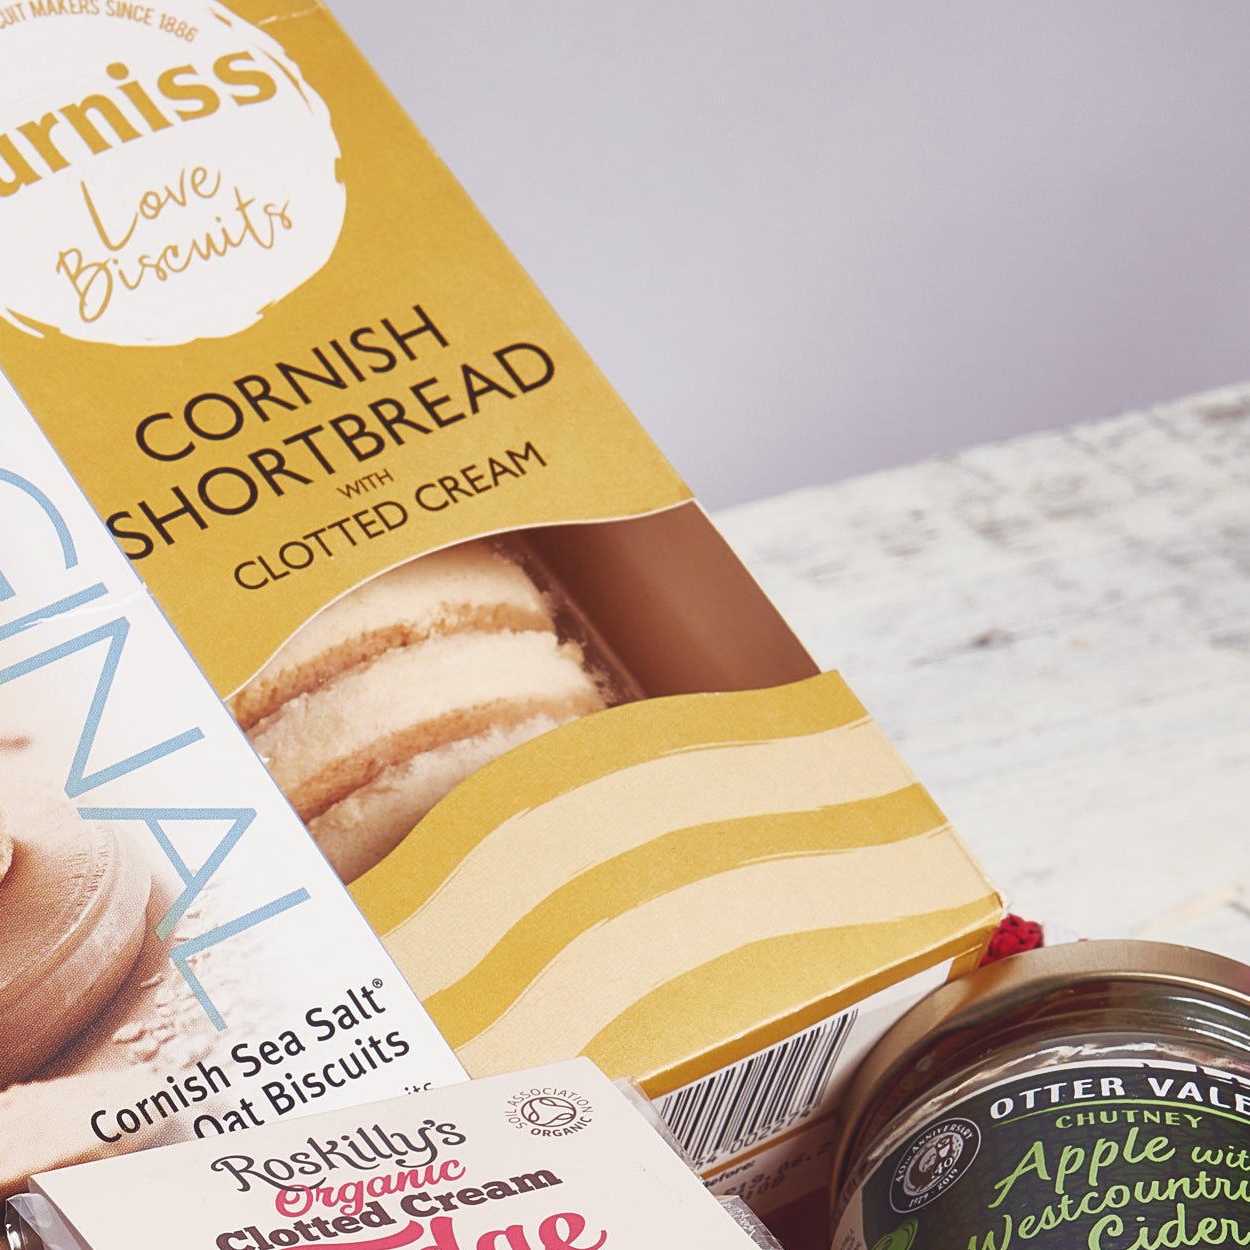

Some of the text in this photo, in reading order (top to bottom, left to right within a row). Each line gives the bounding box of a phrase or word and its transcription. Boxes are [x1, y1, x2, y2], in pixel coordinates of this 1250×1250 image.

[30, 0, 100, 18] MAKERS
[105, 0, 155, 26] SINCE
[158, 13, 198, 42] 1886
[81, 166, 221, 251] Love
[56, 185, 293, 323] Biscuits
[135, 304, 450, 462] CORNISH
[105, 342, 556, 560] SHORTBREAD
[336, 468, 396, 499] WITH
[233, 441, 548, 591] CLOTTED CREAM
[90, 1061, 231, 1143] Cornish
[231, 1030, 306, 1077] Sea
[261, 1030, 410, 1117] Biscuits
[990, 1077, 1125, 1119] OTTER
[504, 1087, 594, 1130] SOIL ASSOCIATION
[530, 1116, 592, 1137] ORGANIC
[912, 1123, 974, 1154] ANNIVERSARY
[1055, 1110, 1202, 1129] CHUTNEY
[210, 1119, 467, 1192] Roskilly's
[275, 1159, 466, 1218] Organic
[988, 1126, 1250, 1208] Apple wit
[399, 1169, 563, 1217] Cream
